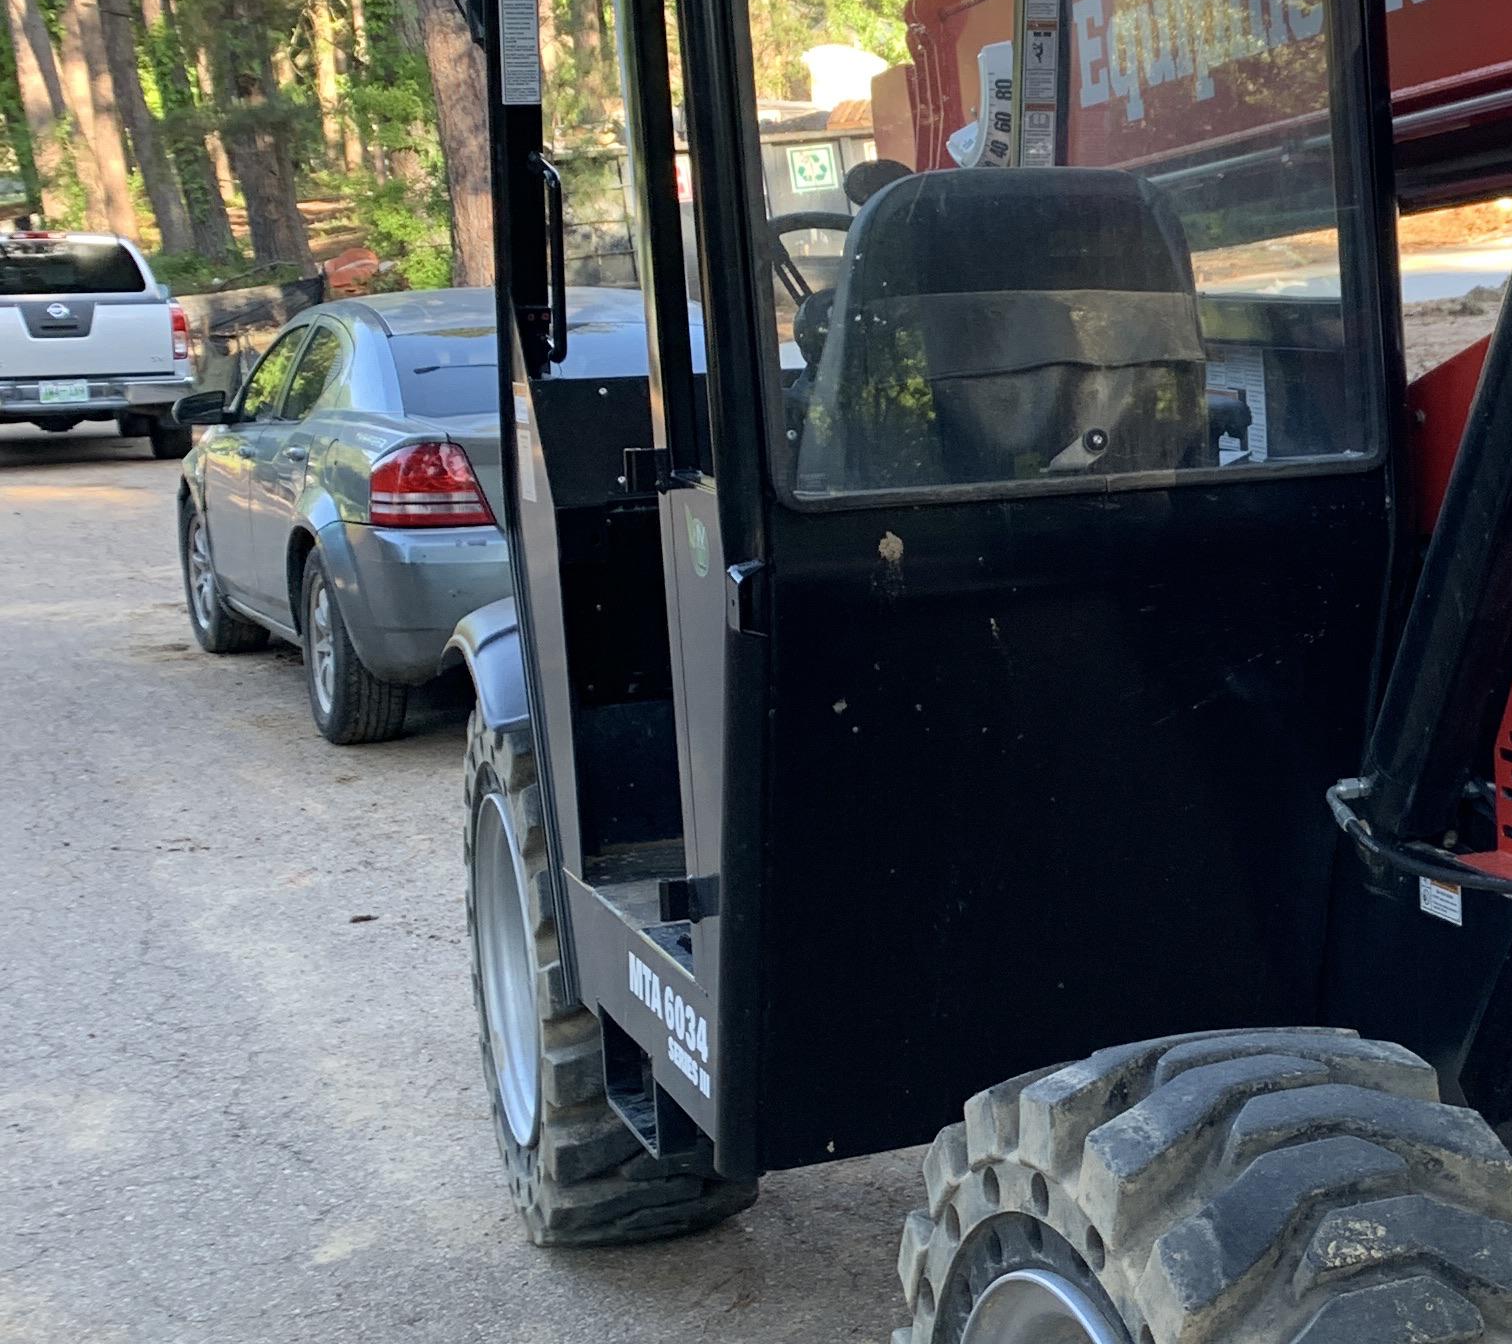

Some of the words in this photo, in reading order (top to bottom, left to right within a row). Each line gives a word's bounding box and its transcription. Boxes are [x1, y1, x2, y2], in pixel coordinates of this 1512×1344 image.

[995, 79, 1012, 100] 80
[994, 112, 1011, 133] 60
[990, 140, 1009, 158] 40
[628, 950, 663, 1020] MTA
[664, 986, 709, 1063] 6034
[667, 1035, 699, 1086] SERIES
